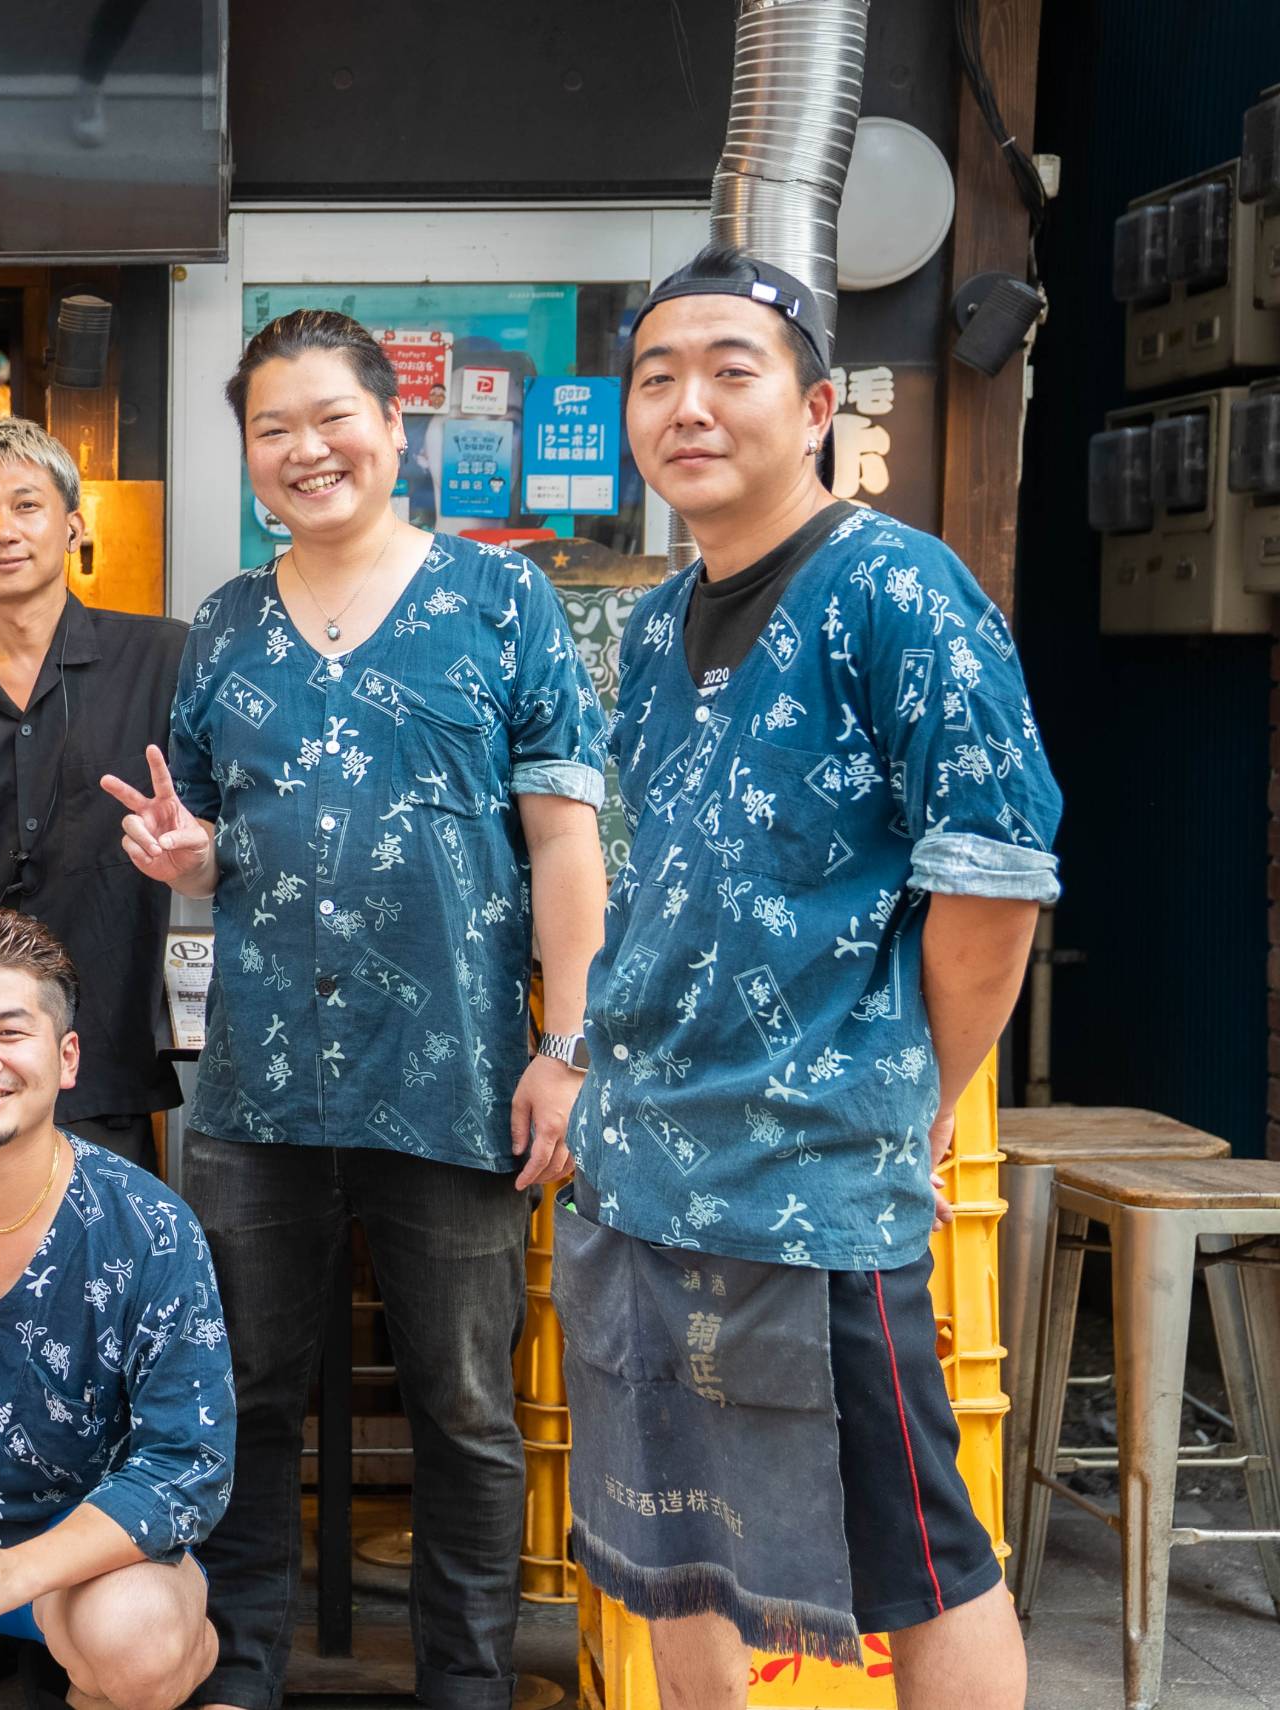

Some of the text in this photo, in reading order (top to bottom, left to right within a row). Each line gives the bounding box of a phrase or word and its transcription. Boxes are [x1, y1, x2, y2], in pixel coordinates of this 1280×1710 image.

[545, 435, 598, 446] クーポン
[703, 667, 729, 685] 2020
